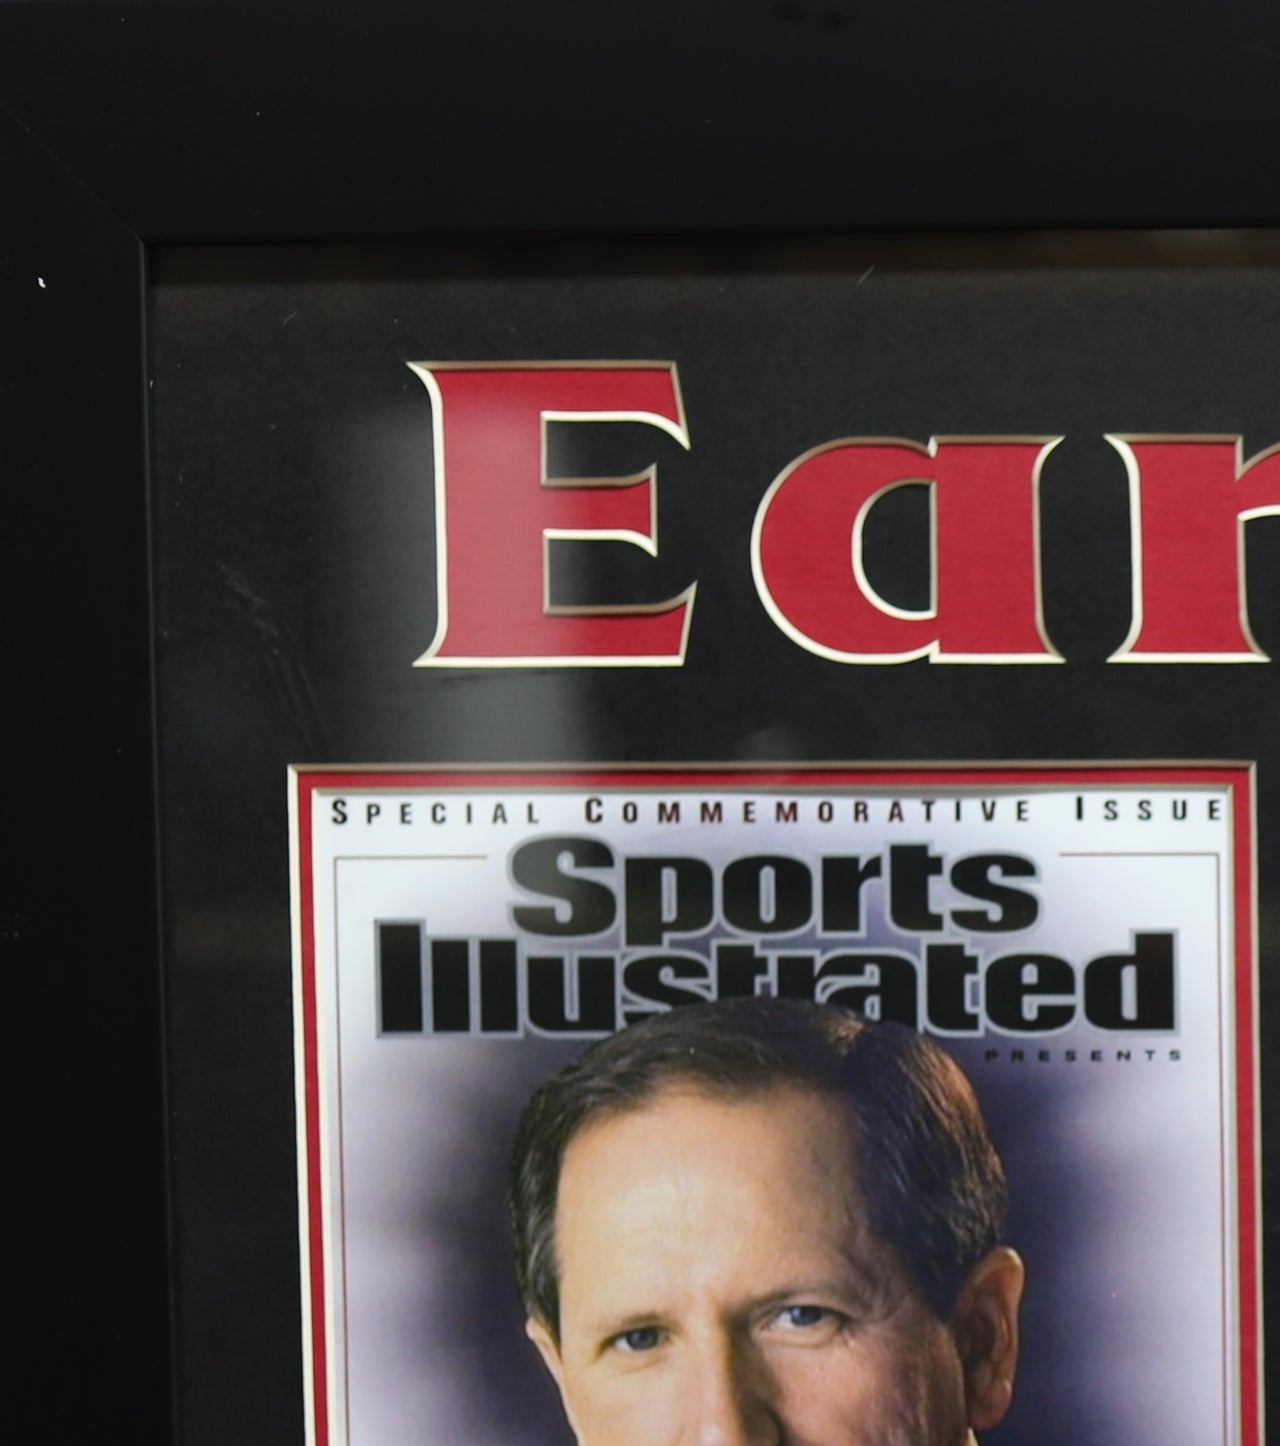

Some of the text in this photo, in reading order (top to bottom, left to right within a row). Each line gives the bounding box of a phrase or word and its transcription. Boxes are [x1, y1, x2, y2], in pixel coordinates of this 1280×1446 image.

[331, 794, 1222, 826] SPECIAL COMMEMORATIVE ISSUE
[506, 832, 1041, 947] Sports
[985, 1049, 1183, 1062] PRESENTS
